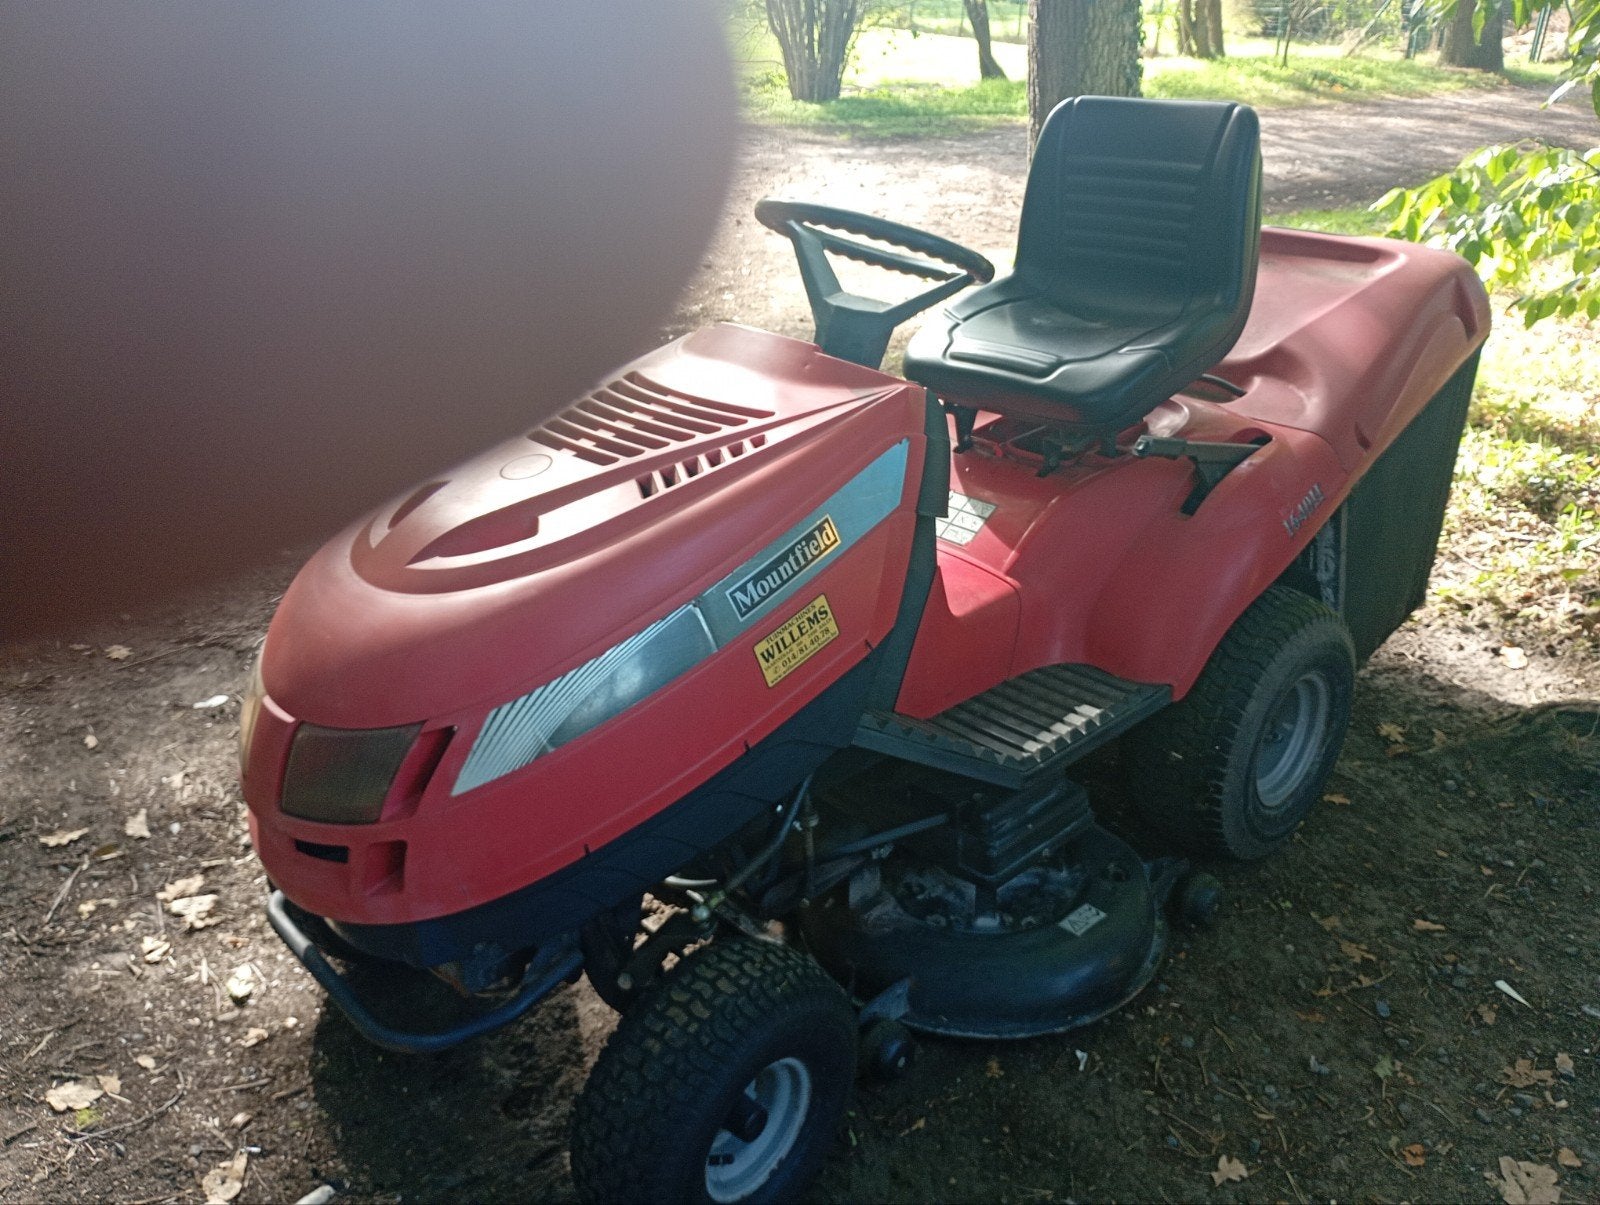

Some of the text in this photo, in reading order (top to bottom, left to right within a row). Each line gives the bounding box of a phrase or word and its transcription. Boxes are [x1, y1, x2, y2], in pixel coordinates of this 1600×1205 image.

[733, 522, 837, 613] Mountfield
[760, 605, 829, 664] WILLEMS
[765, 604, 817, 645] TUINMACHINES
[781, 626, 830, 668] 014/81.40.78
